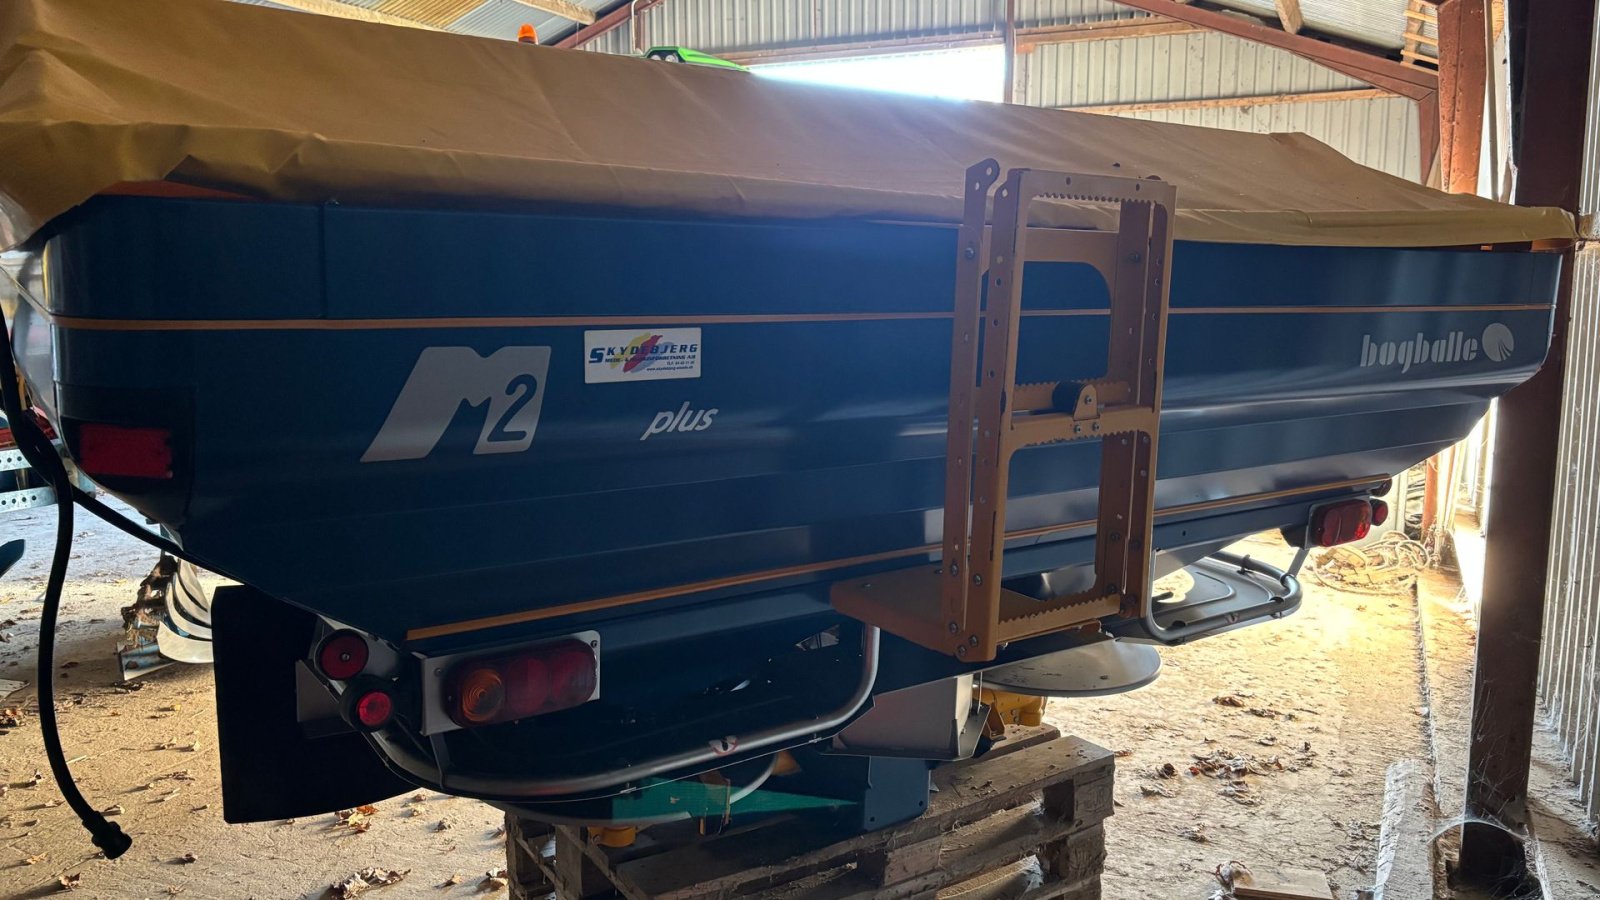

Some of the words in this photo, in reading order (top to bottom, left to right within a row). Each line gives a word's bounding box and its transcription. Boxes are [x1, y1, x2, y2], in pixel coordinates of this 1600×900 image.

[589, 343, 698, 363] SKYDEBJERG
[1360, 331, 1478, 374] bogballe
[640, 401, 719, 440] plus
